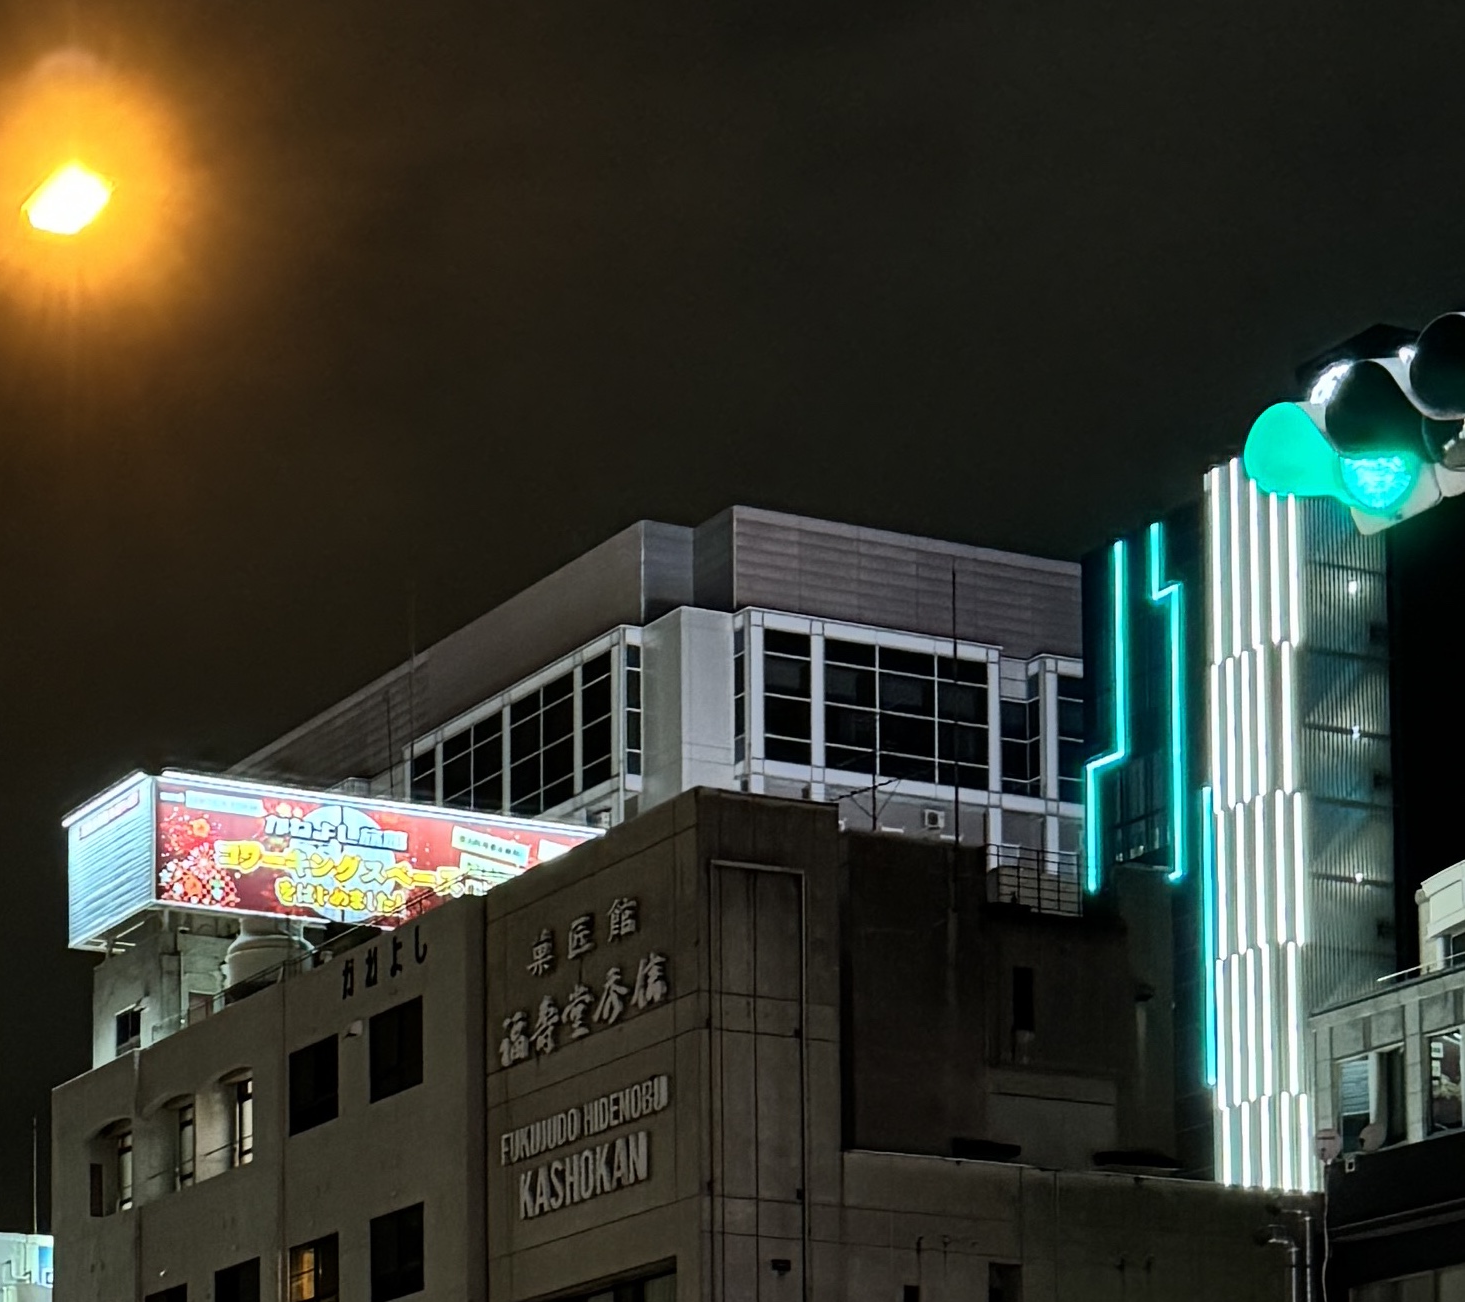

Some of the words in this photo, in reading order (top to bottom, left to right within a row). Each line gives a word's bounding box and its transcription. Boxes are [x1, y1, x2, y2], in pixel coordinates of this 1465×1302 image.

[342, 925, 427, 999] かわよし
[500, 1106, 580, 1166] FUKUJUDO
[583, 1074, 669, 1135] HIDENOBU
[519, 1131, 649, 1220] KASHOKAN
